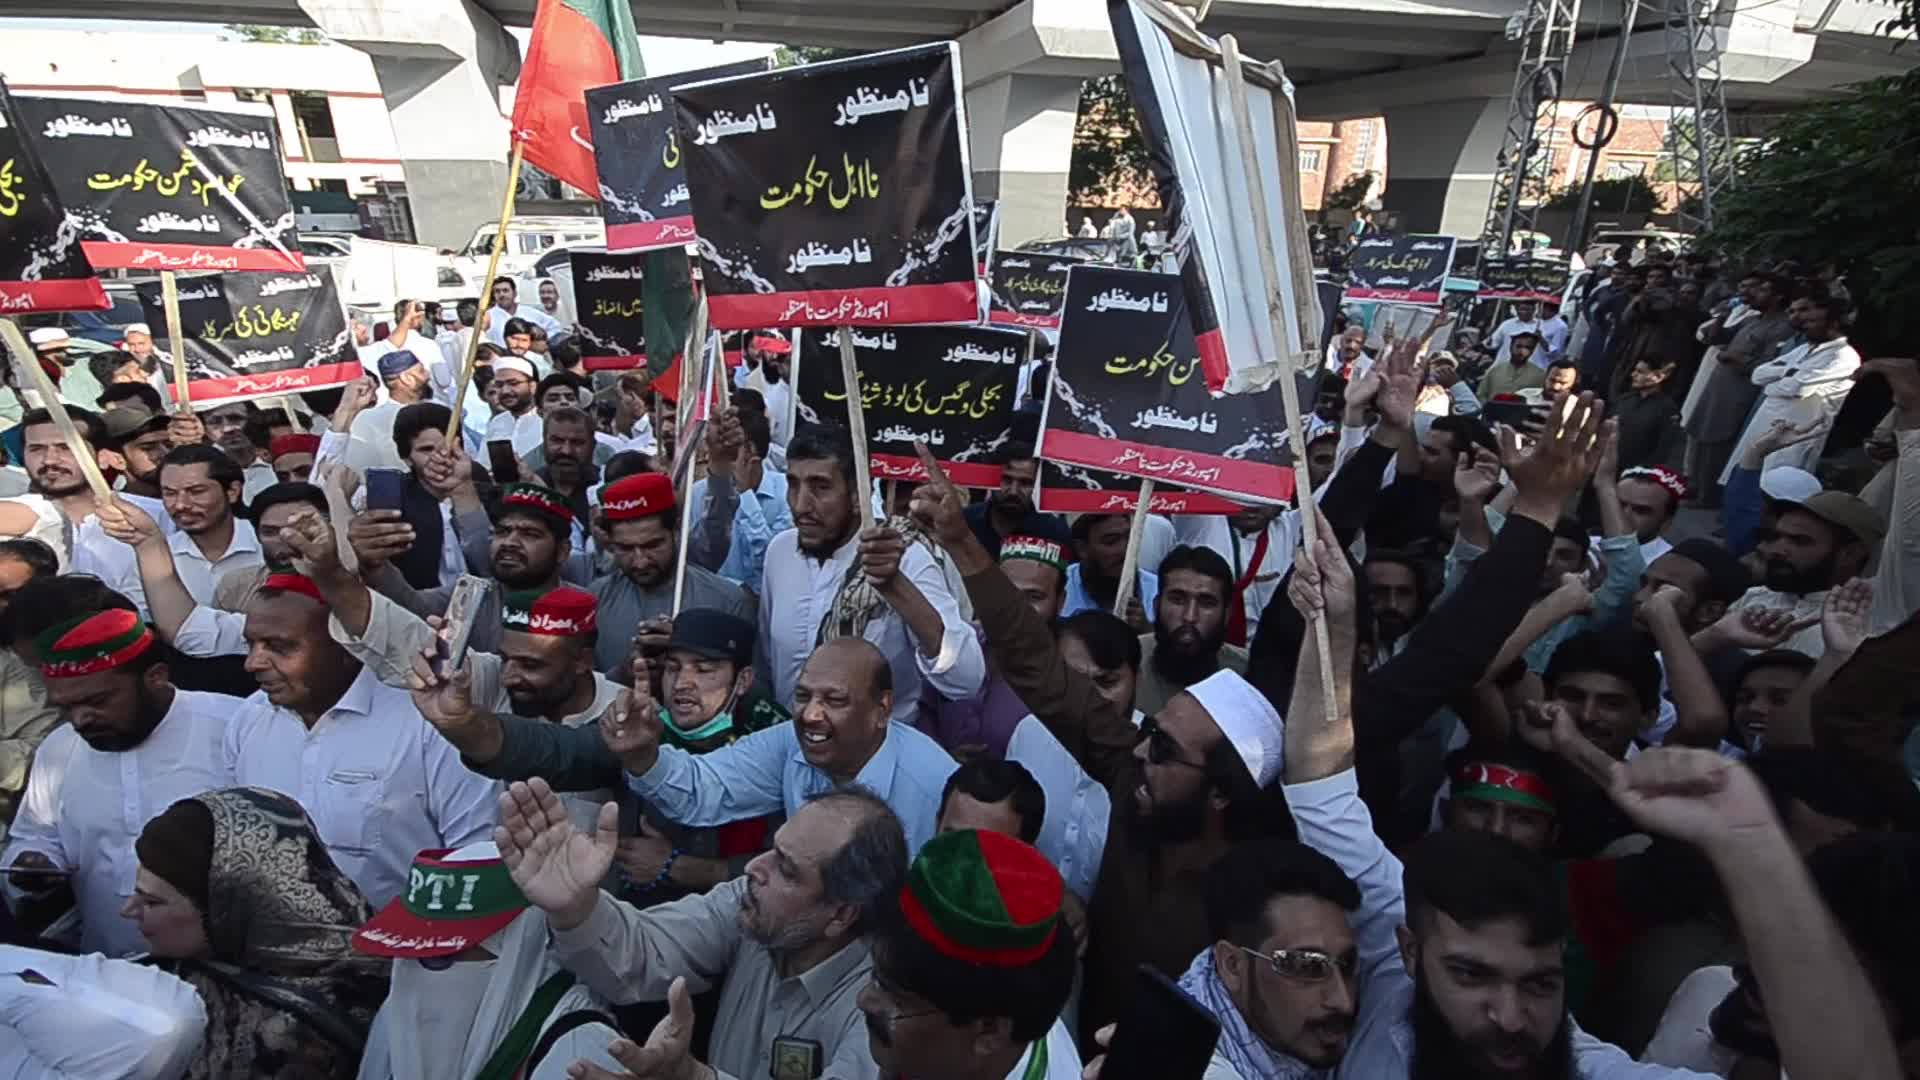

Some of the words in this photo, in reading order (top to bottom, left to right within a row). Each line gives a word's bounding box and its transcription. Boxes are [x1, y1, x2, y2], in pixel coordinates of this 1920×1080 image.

[602, 93, 664, 124] نامنظور
[834, 77, 930, 126] نامنظور
[42, 114, 134, 137] نامنظور
[185, 127, 271, 150] نامنظور
[693, 102, 777, 145] نامنظور
[87, 158, 158, 191] حکومت
[760, 154, 829, 209] حکومت
[136, 211, 220, 232] نامنظور
[785, 236, 872, 274] نامنظور
[259, 274, 323, 297] نامنظور
[1085, 287, 1169, 312] نامنظور
[814, 295, 853, 320] حکومت
[852, 298, 889, 320] امپورٹڈ
[231, 345, 296, 369] نامنظور
[942, 342, 1017, 365] نامنظور
[1104, 339, 1176, 378] حکومت
[903, 379, 927, 414] کی
[924, 380, 970, 416] گیس
[969, 383, 1003, 419] بجلی
[1129, 404, 1218, 434] نامنظور
[871, 424, 945, 446] نامنظور
[408, 866, 480, 911] PTI
